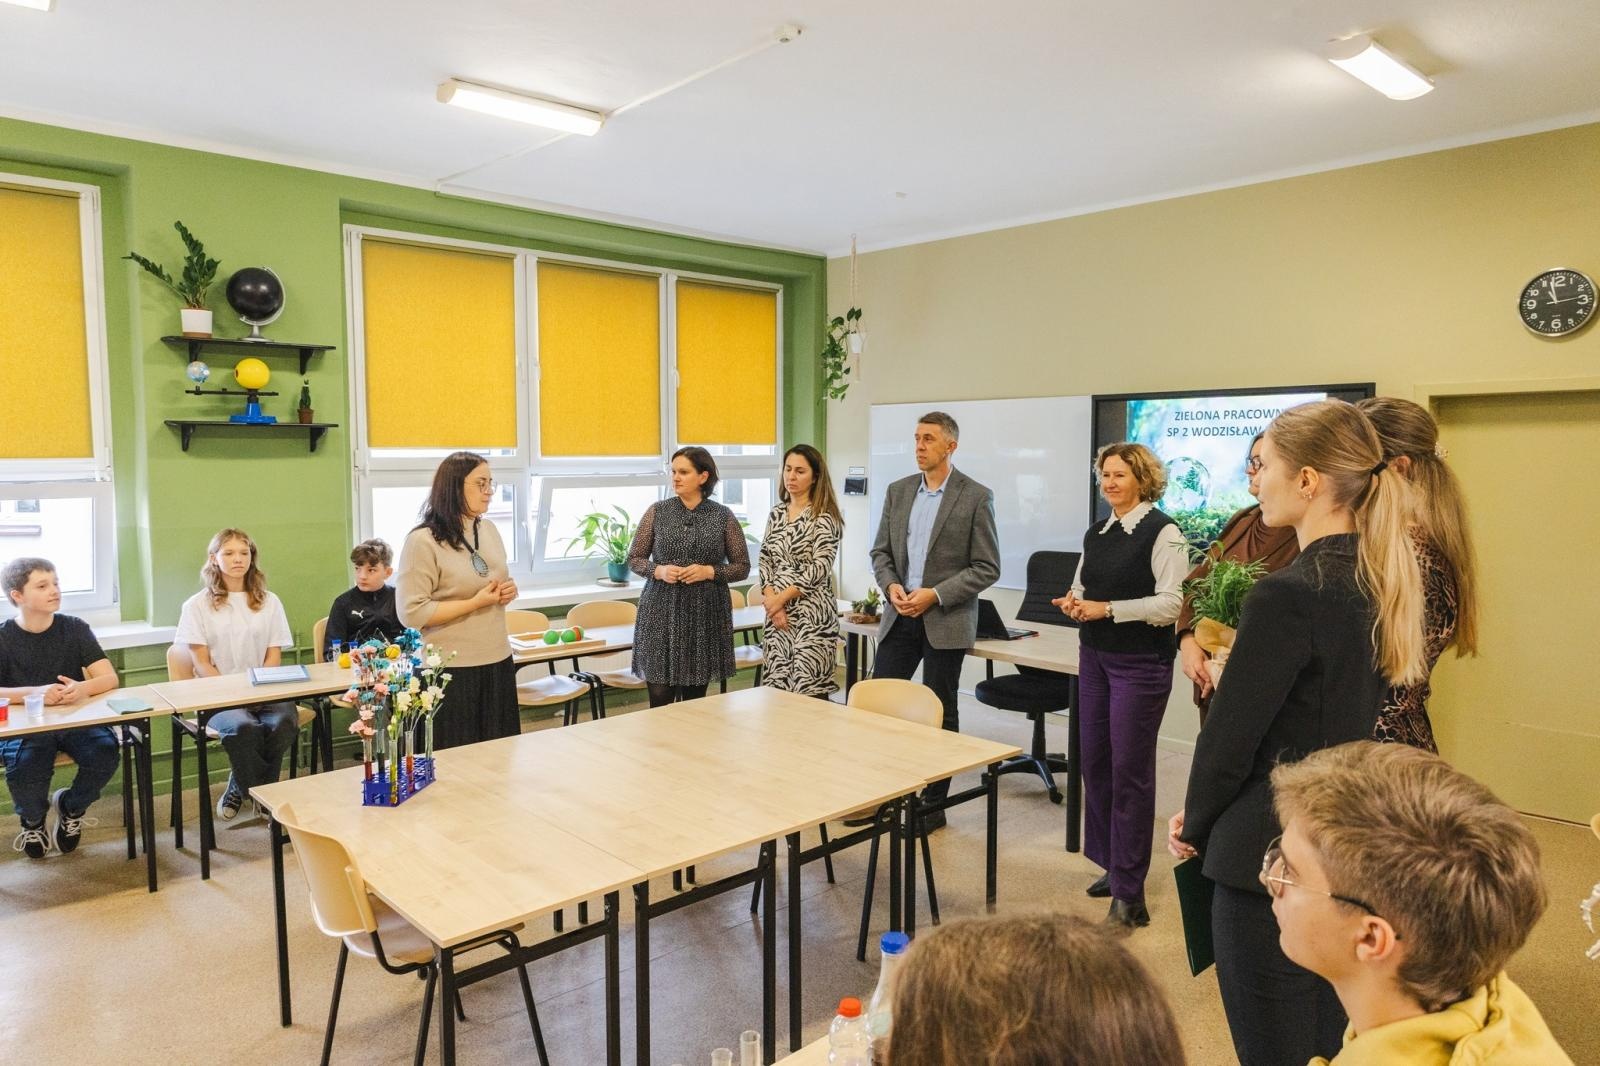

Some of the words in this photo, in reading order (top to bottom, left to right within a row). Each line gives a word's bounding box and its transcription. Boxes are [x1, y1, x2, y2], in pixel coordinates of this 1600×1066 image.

[1577, 284, 1584, 292] 2
[1527, 300, 1537, 309] 9
[1577, 294, 1589, 305] 3
[1539, 321, 1545, 329] 7
[1551, 318, 1561, 329] 6
[1174, 410, 1220, 421] ZIELONA
[1167, 427, 1179, 437] SP
[1182, 427, 1189, 437] 2
[1191, 426, 1262, 437] WODZISŁAW
